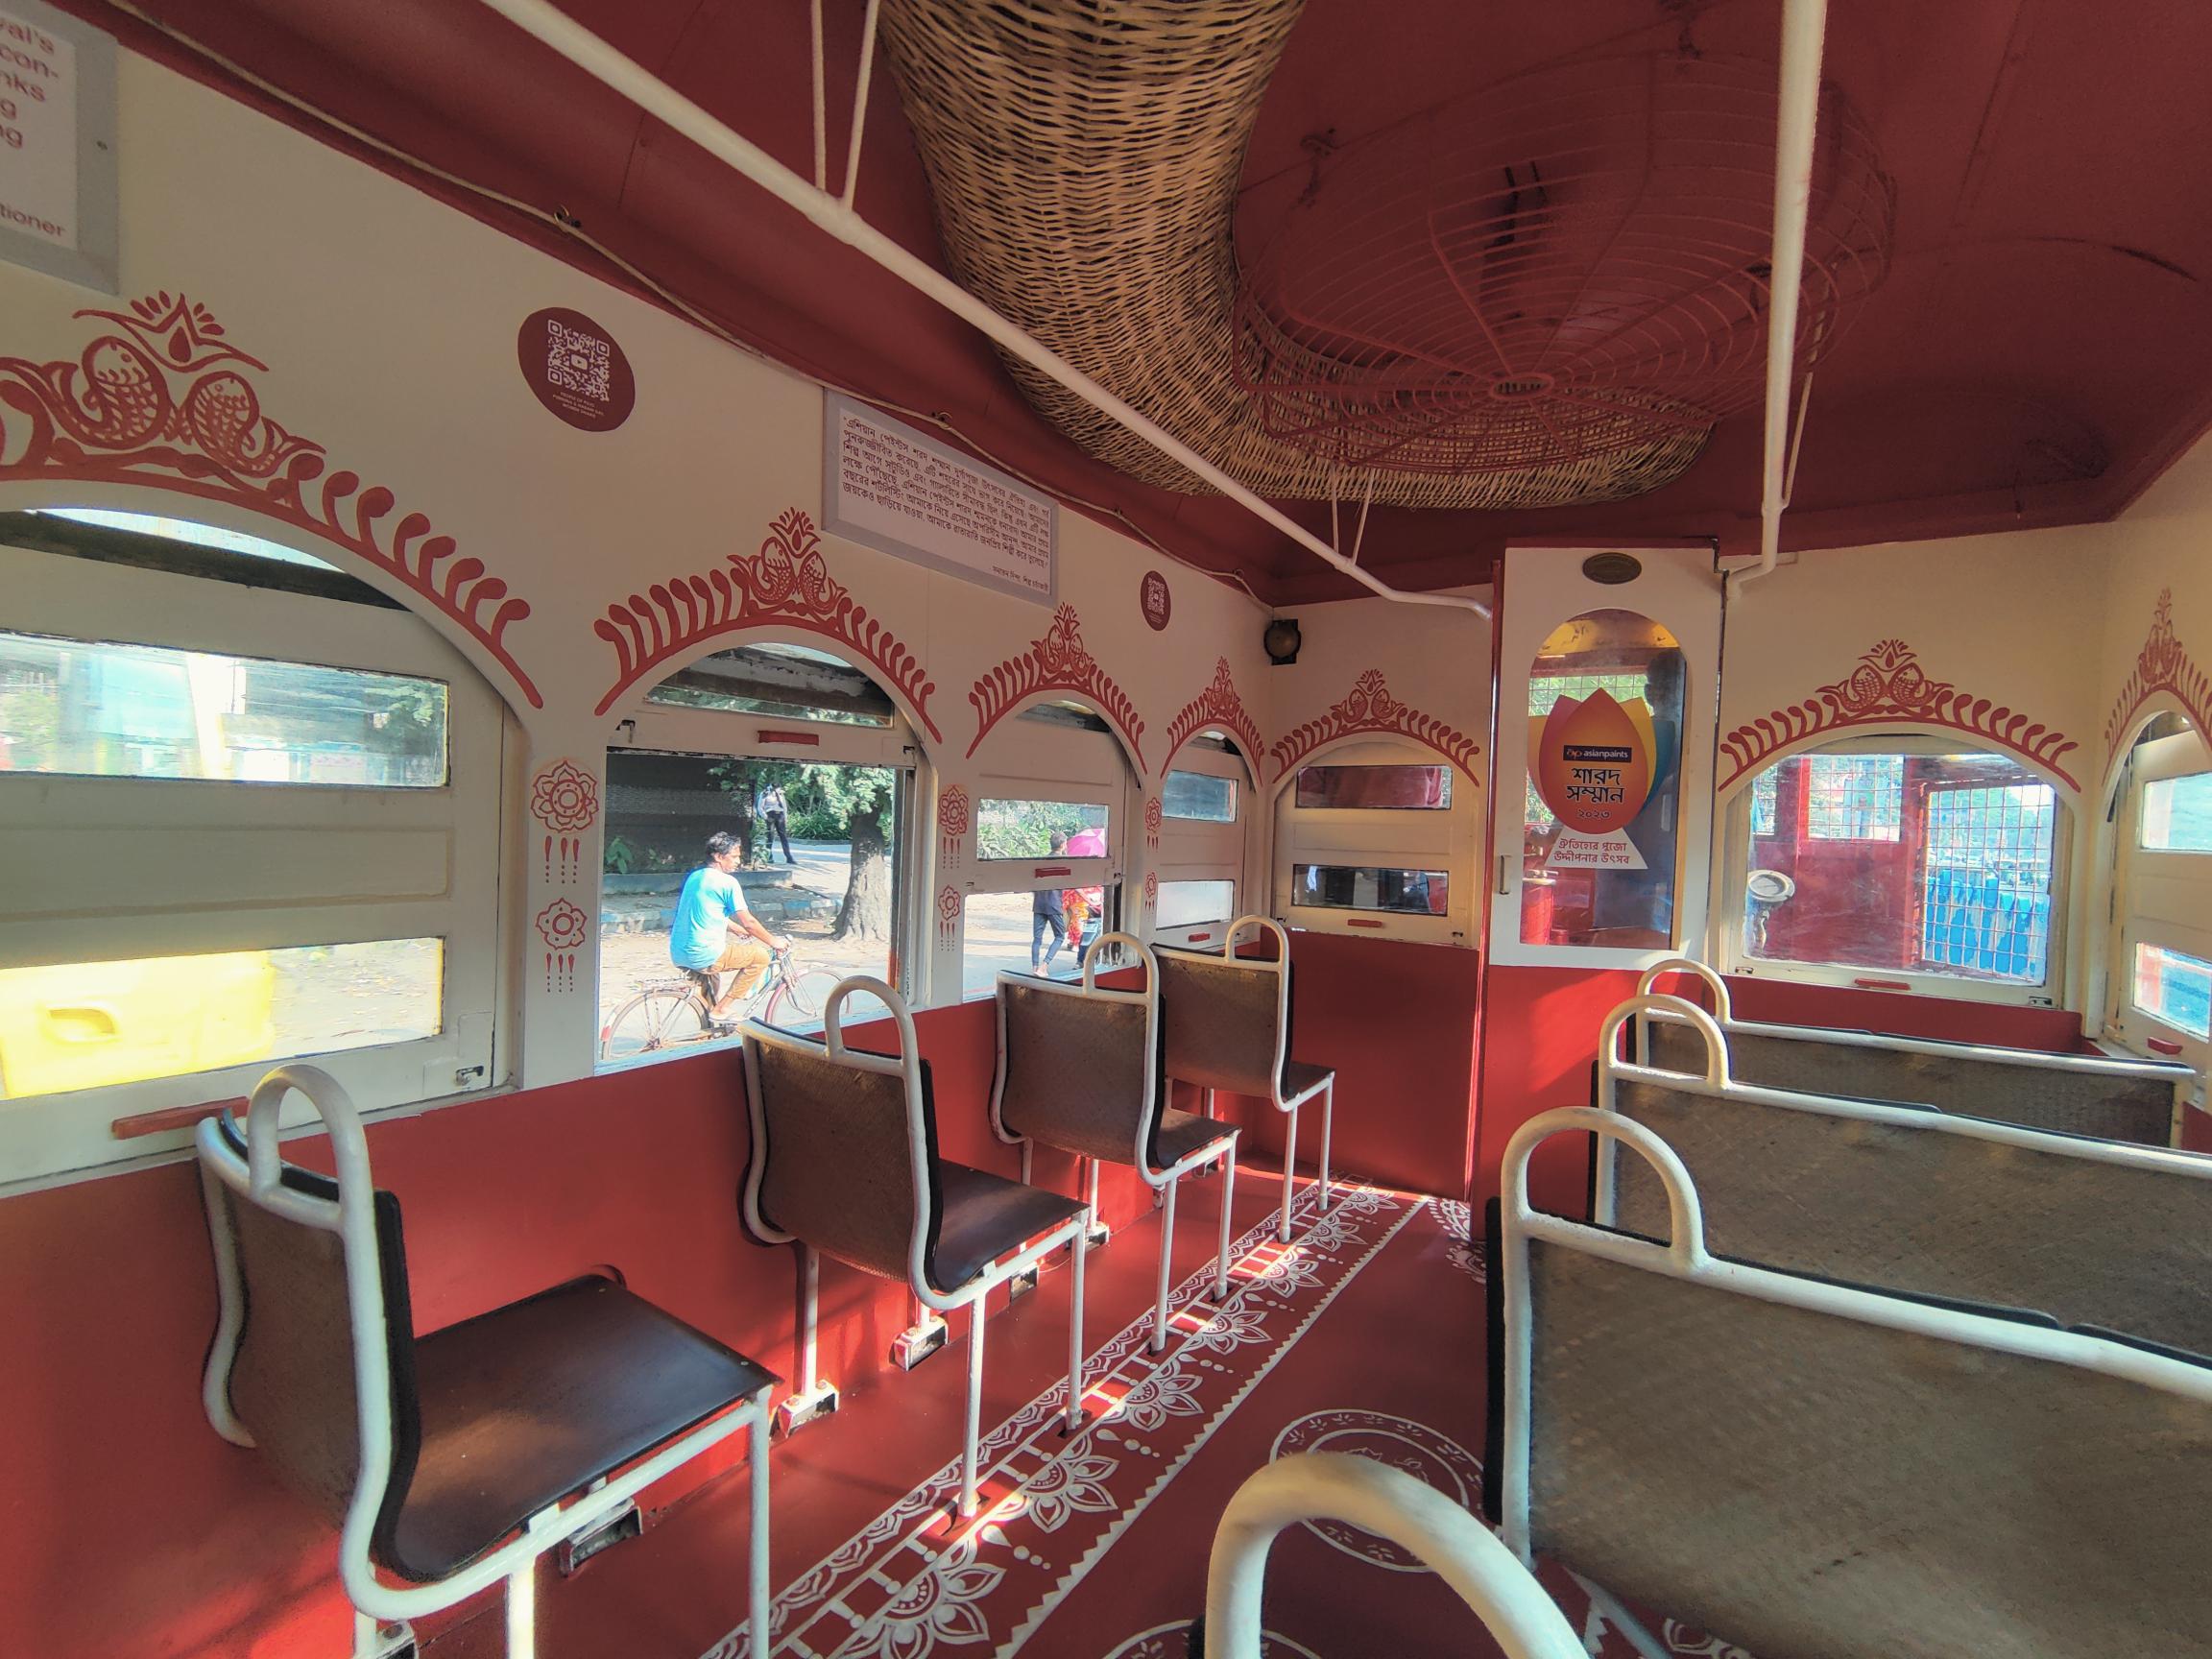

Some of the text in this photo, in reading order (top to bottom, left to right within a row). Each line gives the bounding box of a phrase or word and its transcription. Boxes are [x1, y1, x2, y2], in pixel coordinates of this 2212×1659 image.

[1584, 749, 1628, 759] asianpaints
[1572, 768, 1621, 785] শারদ
[1567, 785, 1624, 803] সম্মান
[1578, 808, 1610, 819] ২০২৩
[1554, 851, 1630, 865] উদ্দীপনার উৎসব
